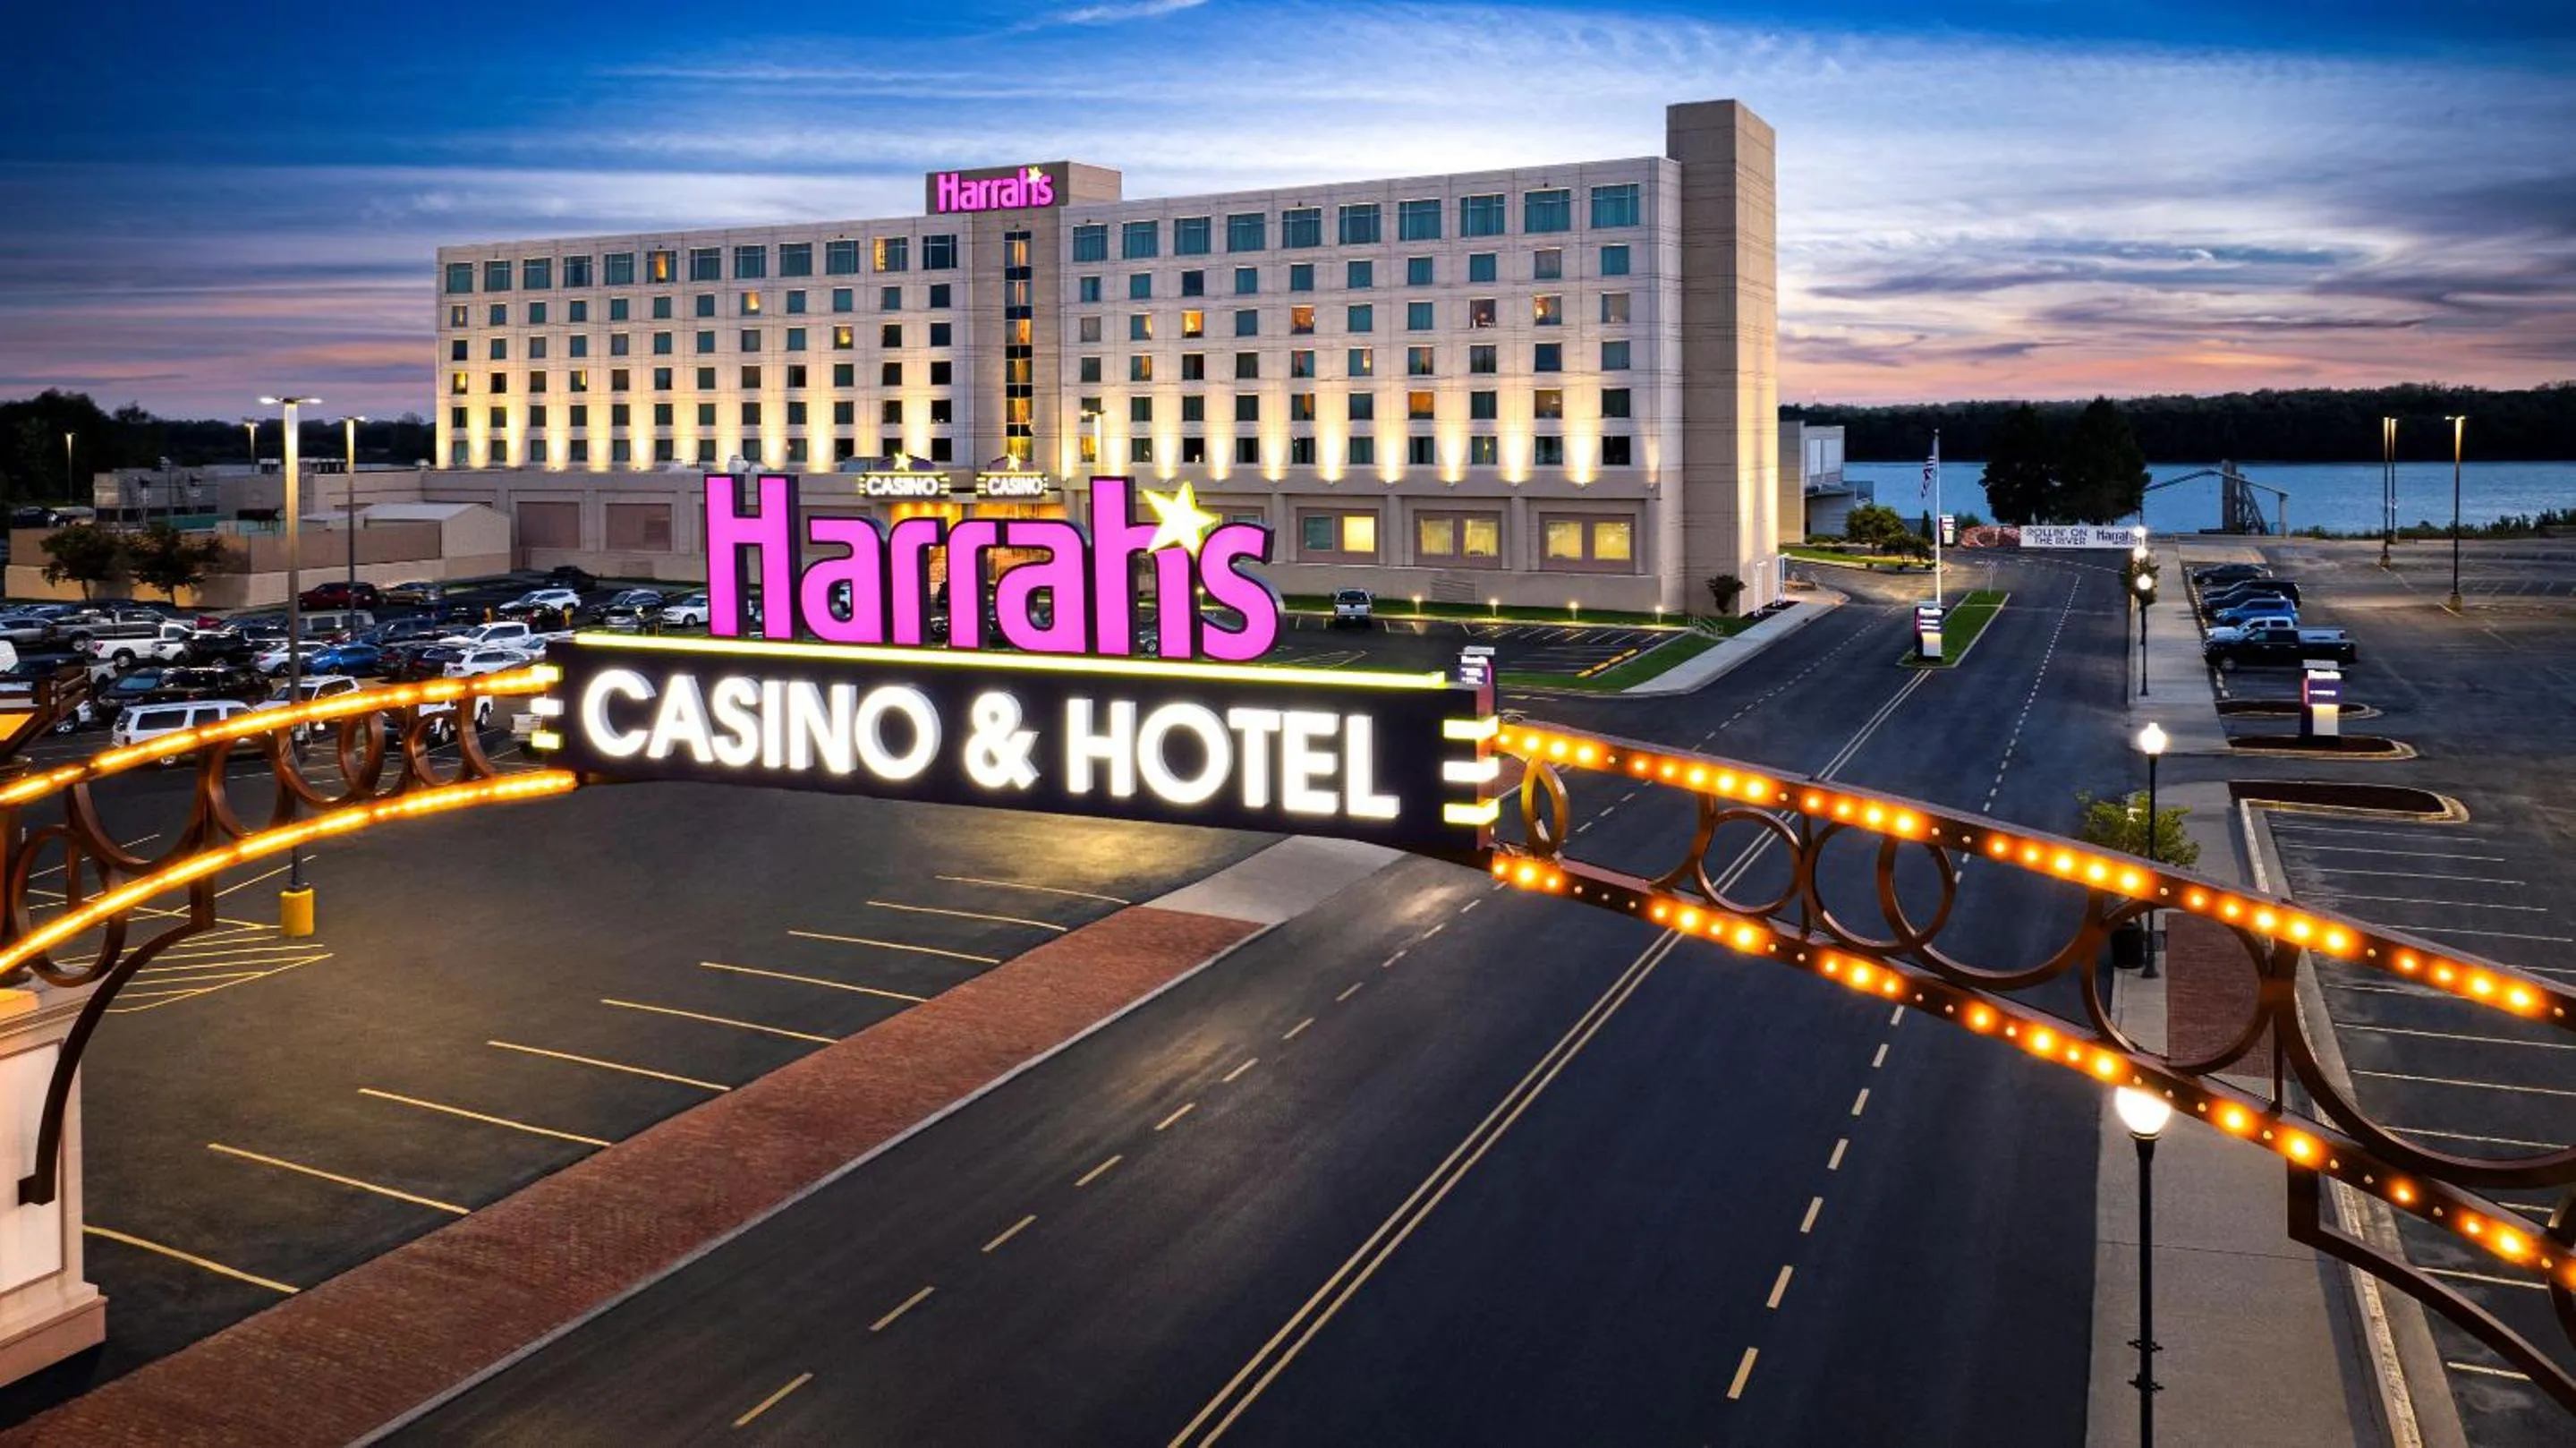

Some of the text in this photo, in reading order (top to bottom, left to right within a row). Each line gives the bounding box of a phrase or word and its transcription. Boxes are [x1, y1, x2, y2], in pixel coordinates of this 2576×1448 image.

[866, 477, 939, 495] CASINO
[987, 477, 1043, 495] CASINO
[2034, 537, 2087, 545] THE RIVER
[2070, 528, 2087, 537] ON
[582, 668, 1401, 820] CASINO & HOTEL
